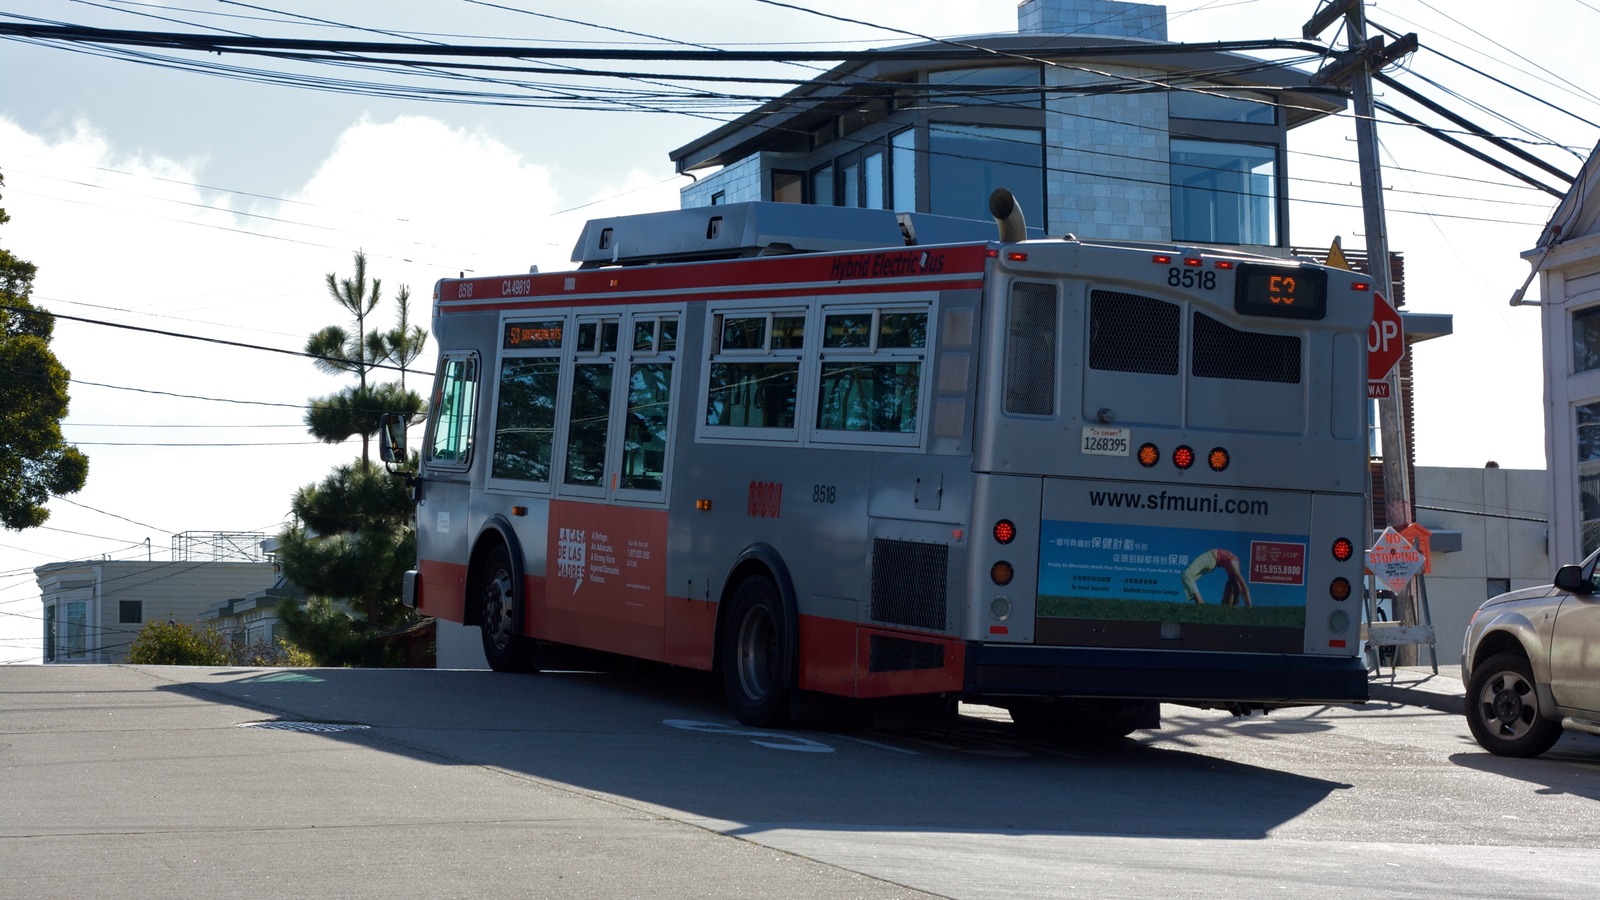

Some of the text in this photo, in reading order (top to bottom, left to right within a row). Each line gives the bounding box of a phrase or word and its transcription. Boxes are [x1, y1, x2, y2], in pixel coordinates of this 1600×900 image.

[831, 254, 871, 282] Hybrid
[872, 251, 918, 275] Electric
[1168, 267, 1216, 290] 8518
[458, 282, 473, 298] 8518
[1270, 276, 1296, 304] 53
[510, 327, 521, 344] 53
[1368, 320, 1398, 352] OP
[1084, 436, 1127, 452] 1268395
[813, 484, 836, 504] 8518
[1089, 491, 1268, 515] www.sfmuni.com
[1385, 533, 1401, 544] NO
[568, 547, 582, 562] LAS
[1370, 551, 1419, 564] STOPPING
[1254, 564, 1301, 575] 415.955.8800
